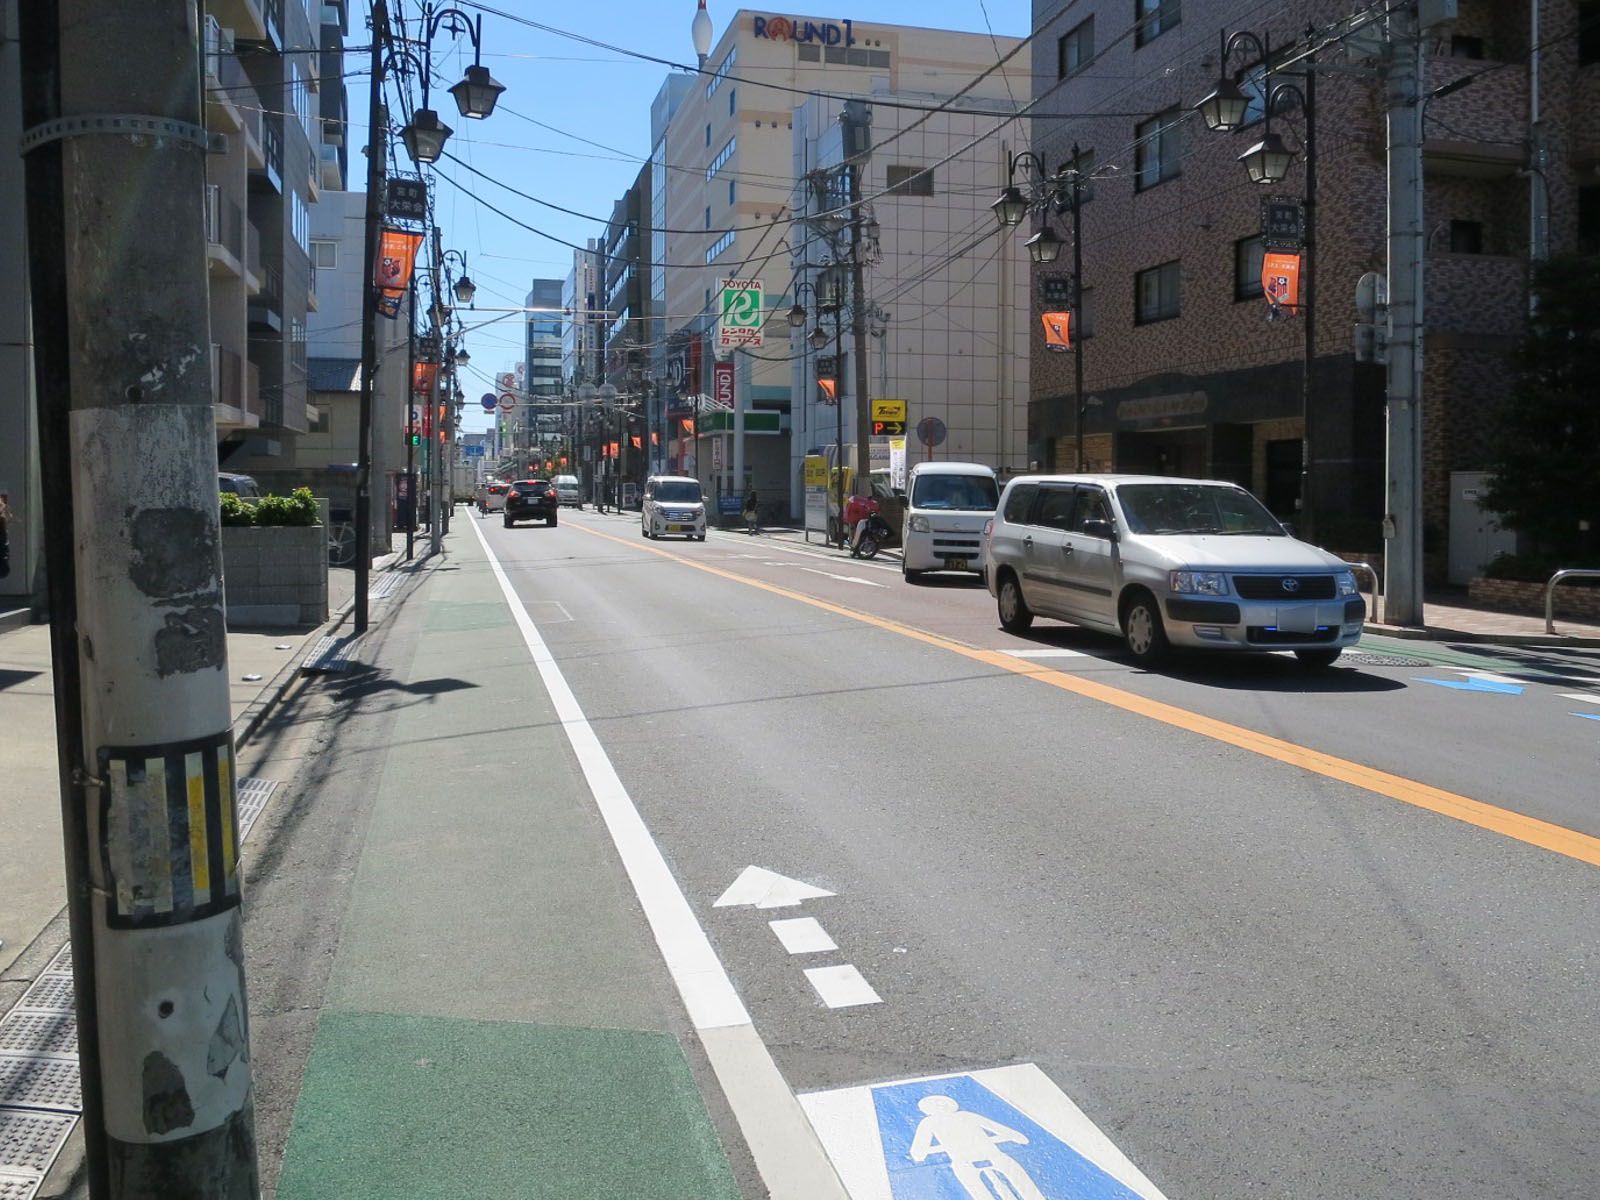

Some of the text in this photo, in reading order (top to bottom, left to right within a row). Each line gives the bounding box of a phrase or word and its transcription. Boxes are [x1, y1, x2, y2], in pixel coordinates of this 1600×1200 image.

[721, 279, 761, 290] TOYOTA
[721, 337, 761, 346] カーリース
[874, 421, 884, 435] P
